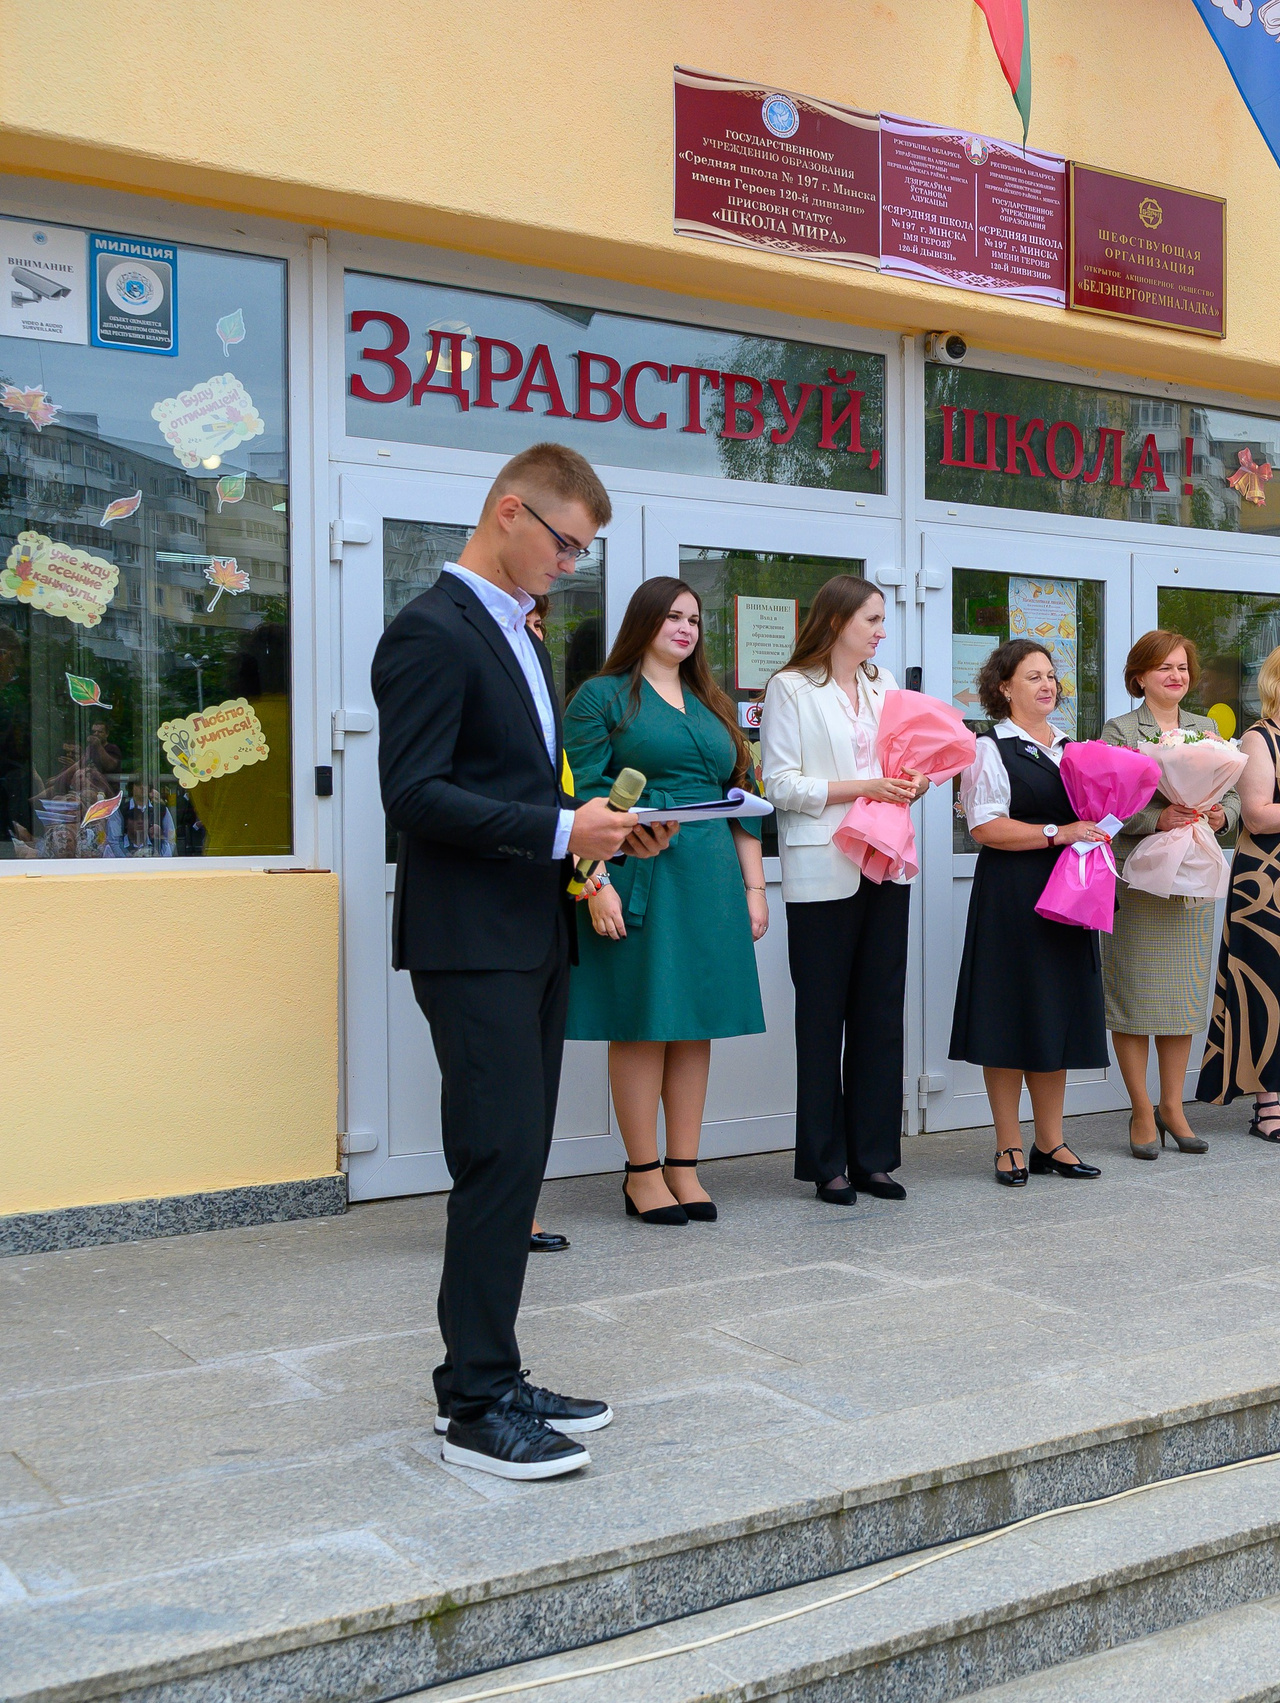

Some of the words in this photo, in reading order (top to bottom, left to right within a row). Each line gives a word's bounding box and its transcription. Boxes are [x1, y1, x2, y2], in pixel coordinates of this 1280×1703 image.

[726, 129, 834, 161] ГОСУДАРСТВЕННОМУ
[894, 138, 930, 152] РЭСПУБЛІКА
[932, 147, 962, 159] БЕЛАРУСЬ
[703, 137, 779, 162] УЧРЕЖДЕНИЮ
[782, 156, 855, 179] ОБРАЗОВАНИЯ
[679, 150, 736, 171] «Средняя
[740, 166, 778, 180] школа
[782, 171, 793, 183] №
[798, 175, 818, 188] 197
[833, 183, 876, 201] Минска
[990, 161, 1026, 174] РЕСПУБЛИКА
[1028, 170, 1055, 181] БЕЛАРУСЬ
[692, 172, 730, 187] имени
[734, 178, 776, 196] Героев
[780, 189, 808, 203] 120-й
[812, 198, 864, 215] дивизии»
[904, 177, 952, 192] ДЗЯРЖАЎНАЯ
[728, 196, 789, 216] ПРИСВОЕН
[792, 209, 832, 225] СТАТУС
[911, 195, 948, 208] АДУКАЦЫІ
[992, 197, 1054, 216] ГОСУДАРСТВЕННОЕ
[712, 208, 787, 233] «ШКОЛА
[792, 222, 846, 244] МИРА»
[883, 205, 936, 222] «СЯРЭДНЯЯ
[940, 216, 974, 230] ШКОЛА
[1000, 215, 1046, 230] ОБРАЗОВАНИЯ
[1001, 207, 1045, 222] УЧРЕЖДЕНИЕ
[892, 218, 900, 227] №
[902, 221, 915, 230] 197
[929, 226, 967, 241] МІНСКА
[903, 233, 918, 242] ІМЯ
[921, 236, 951, 248] ГЕРОЯЎ
[979, 226, 1027, 242] «СРЕДНЯЯ
[1029, 235, 1063, 249] ШКОЛА
[95, 239, 173, 259] МИЛИЦИЯ
[899, 244, 918, 254] 120-Й
[984, 238, 993, 247] №
[995, 241, 1007, 249] 197
[1020, 245, 1058, 260] МИНСКА
[1099, 229, 1201, 260] ШЕФСТВУЮЩАЯ
[8, 257, 74, 273] ВНИМАНИЕ
[992, 250, 1019, 262] ИМЕНИ
[1021, 257, 1050, 268] ГЕРОЕВ
[1105, 248, 1195, 276] ОРГАНИЗАЦИЯ
[991, 262, 1009, 272] 120-Й
[1010, 266, 1051, 280] ДИВИЗИИ»
[1084, 264, 1121, 278] ОТКРЫТОЕ
[1125, 274, 1174, 290] АКЦИОНЕРНОЕ
[1178, 285, 1214, 297] ОБЩЕСТВО
[1078, 278, 1219, 316] «БЕЛЭНЕРГОРЕМНАЛАДКА»
[22, 325, 62, 334] SURVEILLANCE
[181, 388, 213, 408] Буду
[350, 310, 881, 470] ЗДРАВСТВУЙ,
[170, 389, 240, 429] отличницей!
[50, 549, 78, 565] уже
[81, 562, 110, 580] жду
[48, 564, 102, 590] осенние
[746, 604, 790, 612] ВНИМАНИЕ!
[192, 706, 244, 732] Люблю
[196, 717, 252, 749] учиться!
